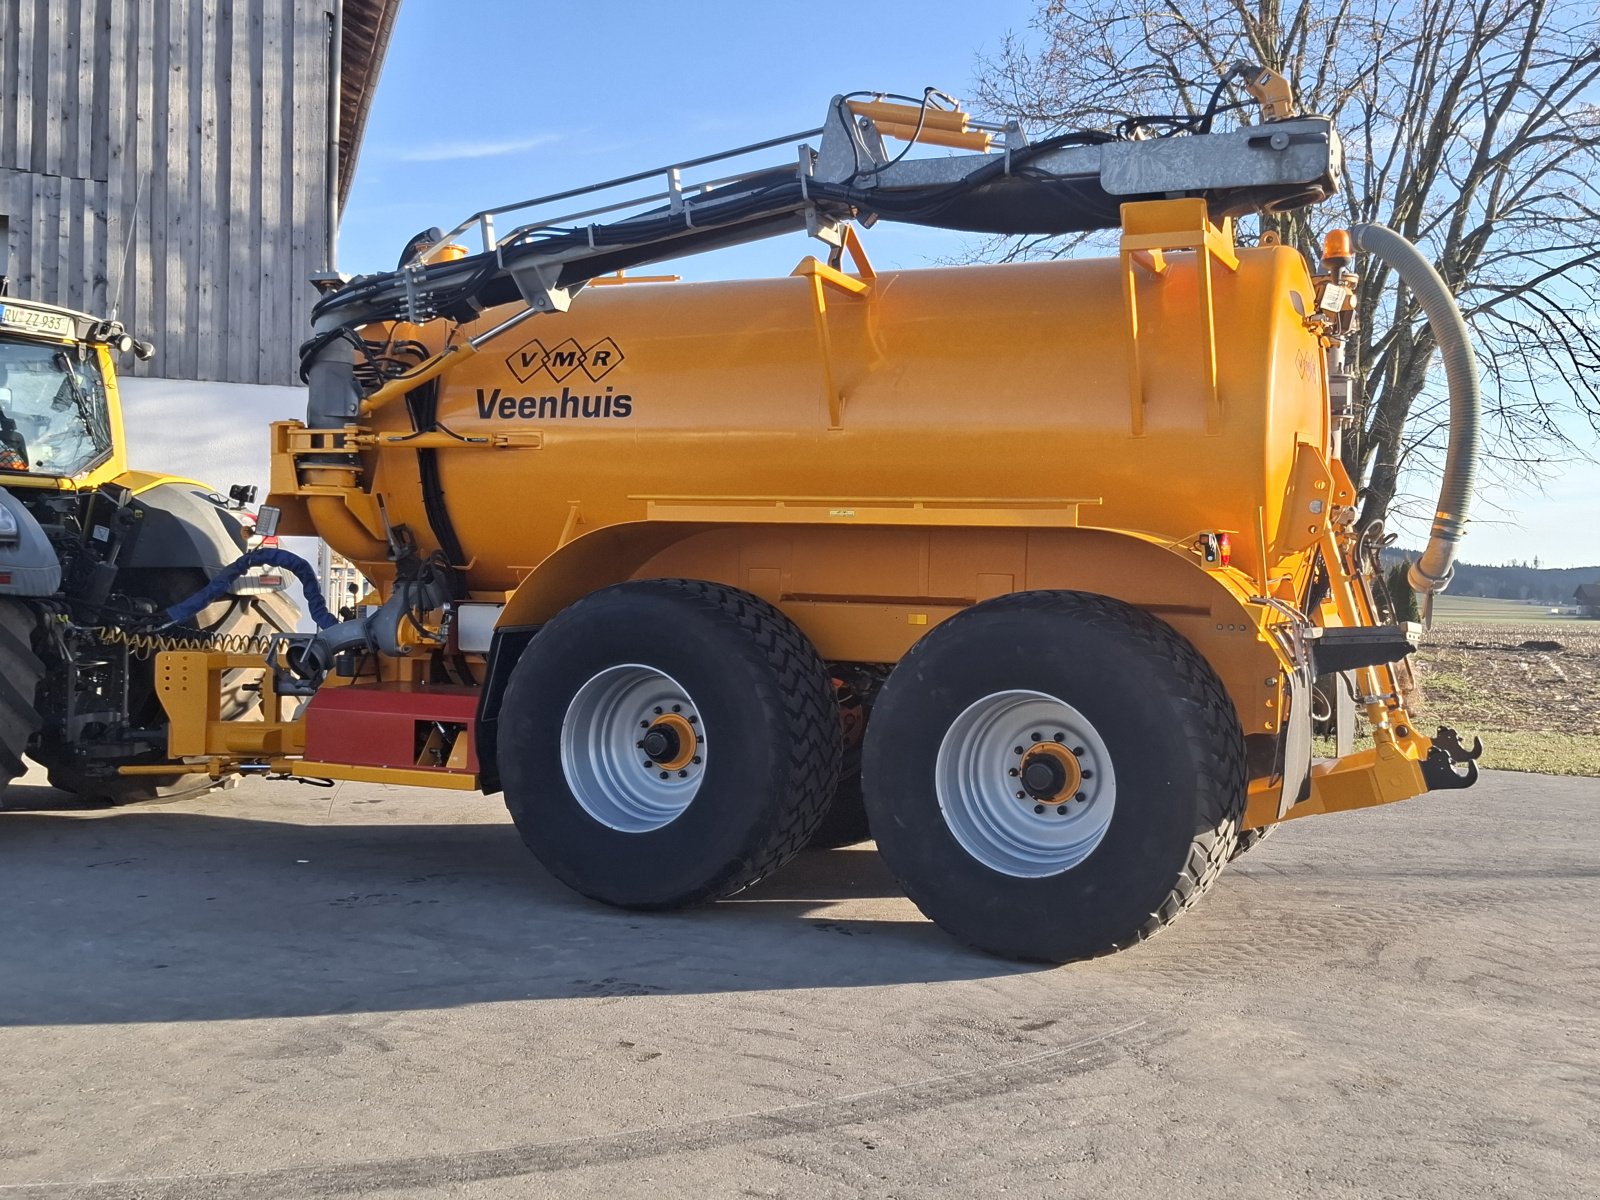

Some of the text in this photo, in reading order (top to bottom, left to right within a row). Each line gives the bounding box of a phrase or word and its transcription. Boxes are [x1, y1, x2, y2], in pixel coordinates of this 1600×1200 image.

[4, 309, 62, 330] RV ZZ 933
[476, 386, 633, 419] Veenhuis
